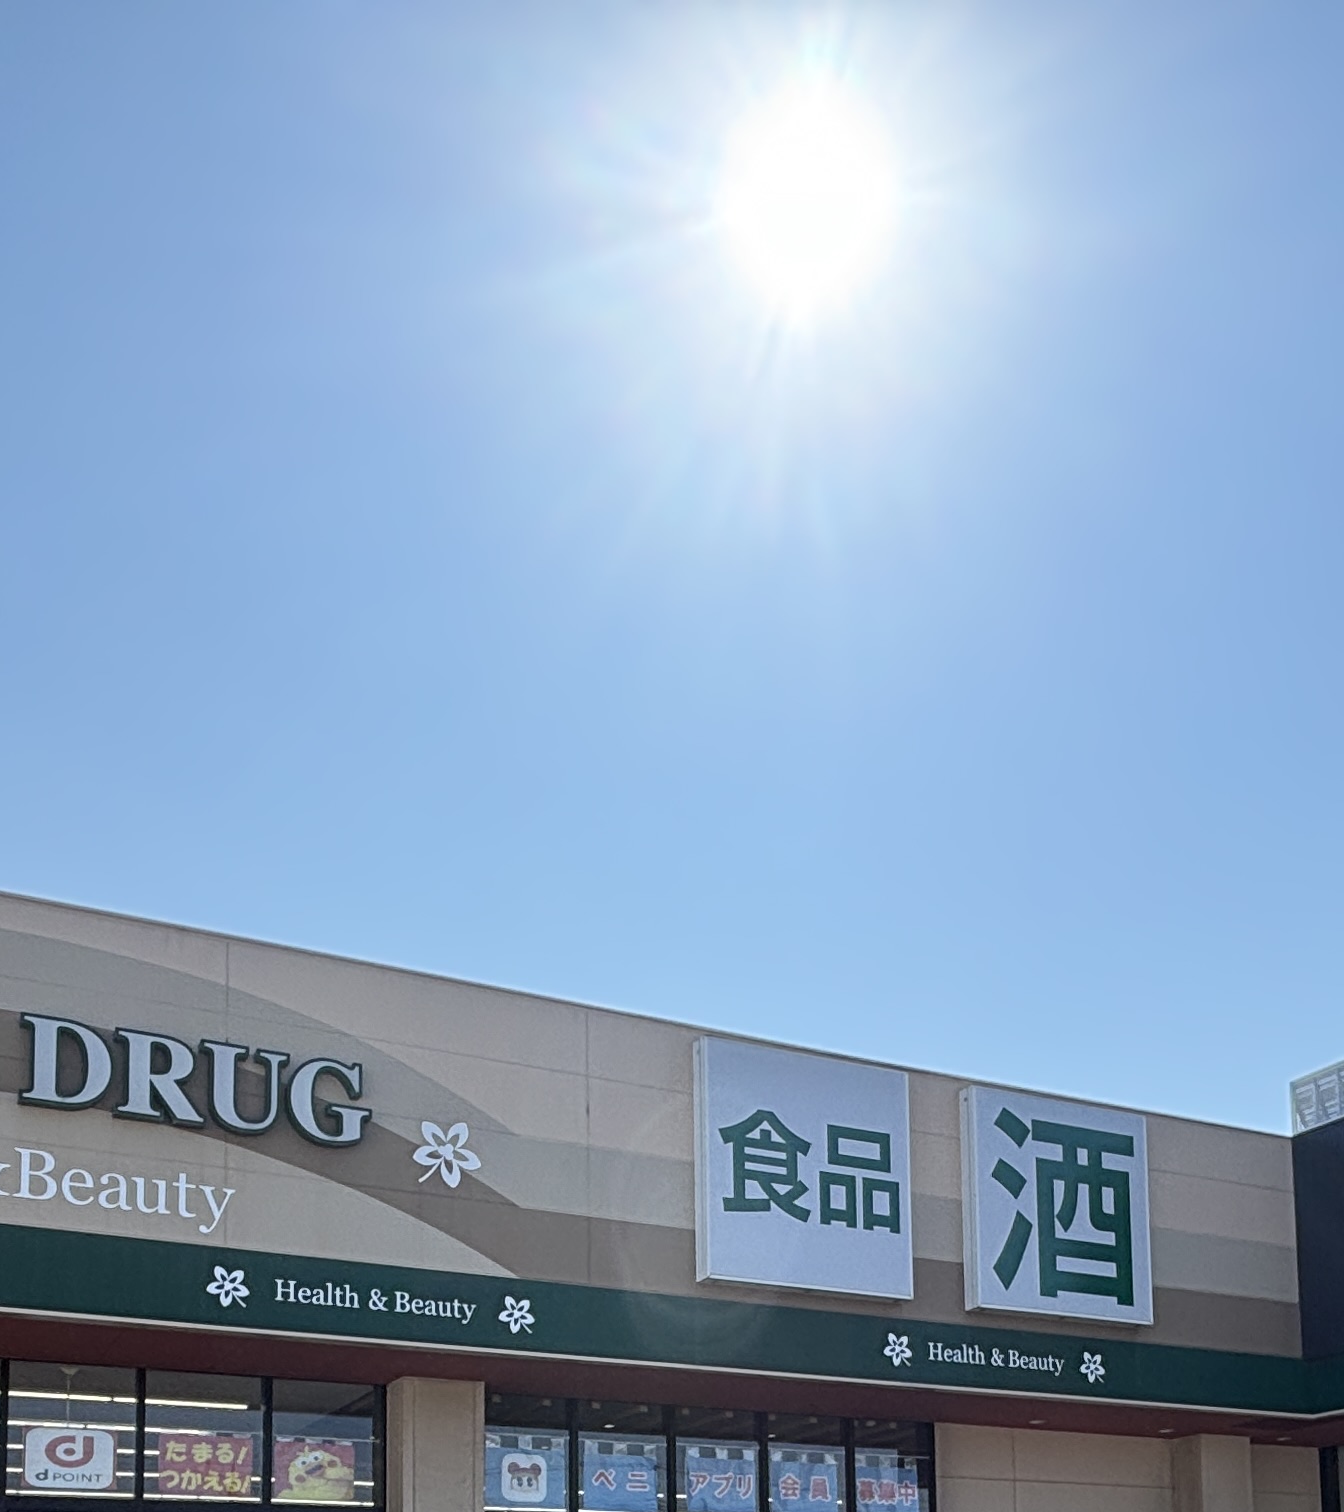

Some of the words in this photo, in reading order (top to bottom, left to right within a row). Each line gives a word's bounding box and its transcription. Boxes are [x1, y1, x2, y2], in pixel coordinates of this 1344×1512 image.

[19, 1011, 373, 1149] DRUG
[717, 1109, 901, 1234] 食品
[991, 1106, 1135, 1307] 酒
[274, 1278, 360, 1310] Health
[368, 1288, 389, 1312] &
[394, 1291, 477, 1325] Beauty
[927, 1341, 986, 1367] Health
[990, 1348, 1005, 1368] &
[1008, 1349, 1065, 1376] Beauty
[53, 1472, 103, 1483] POINT
[689, 1472, 754, 1499] アプリ
[779, 1475, 831, 1502] 会員
